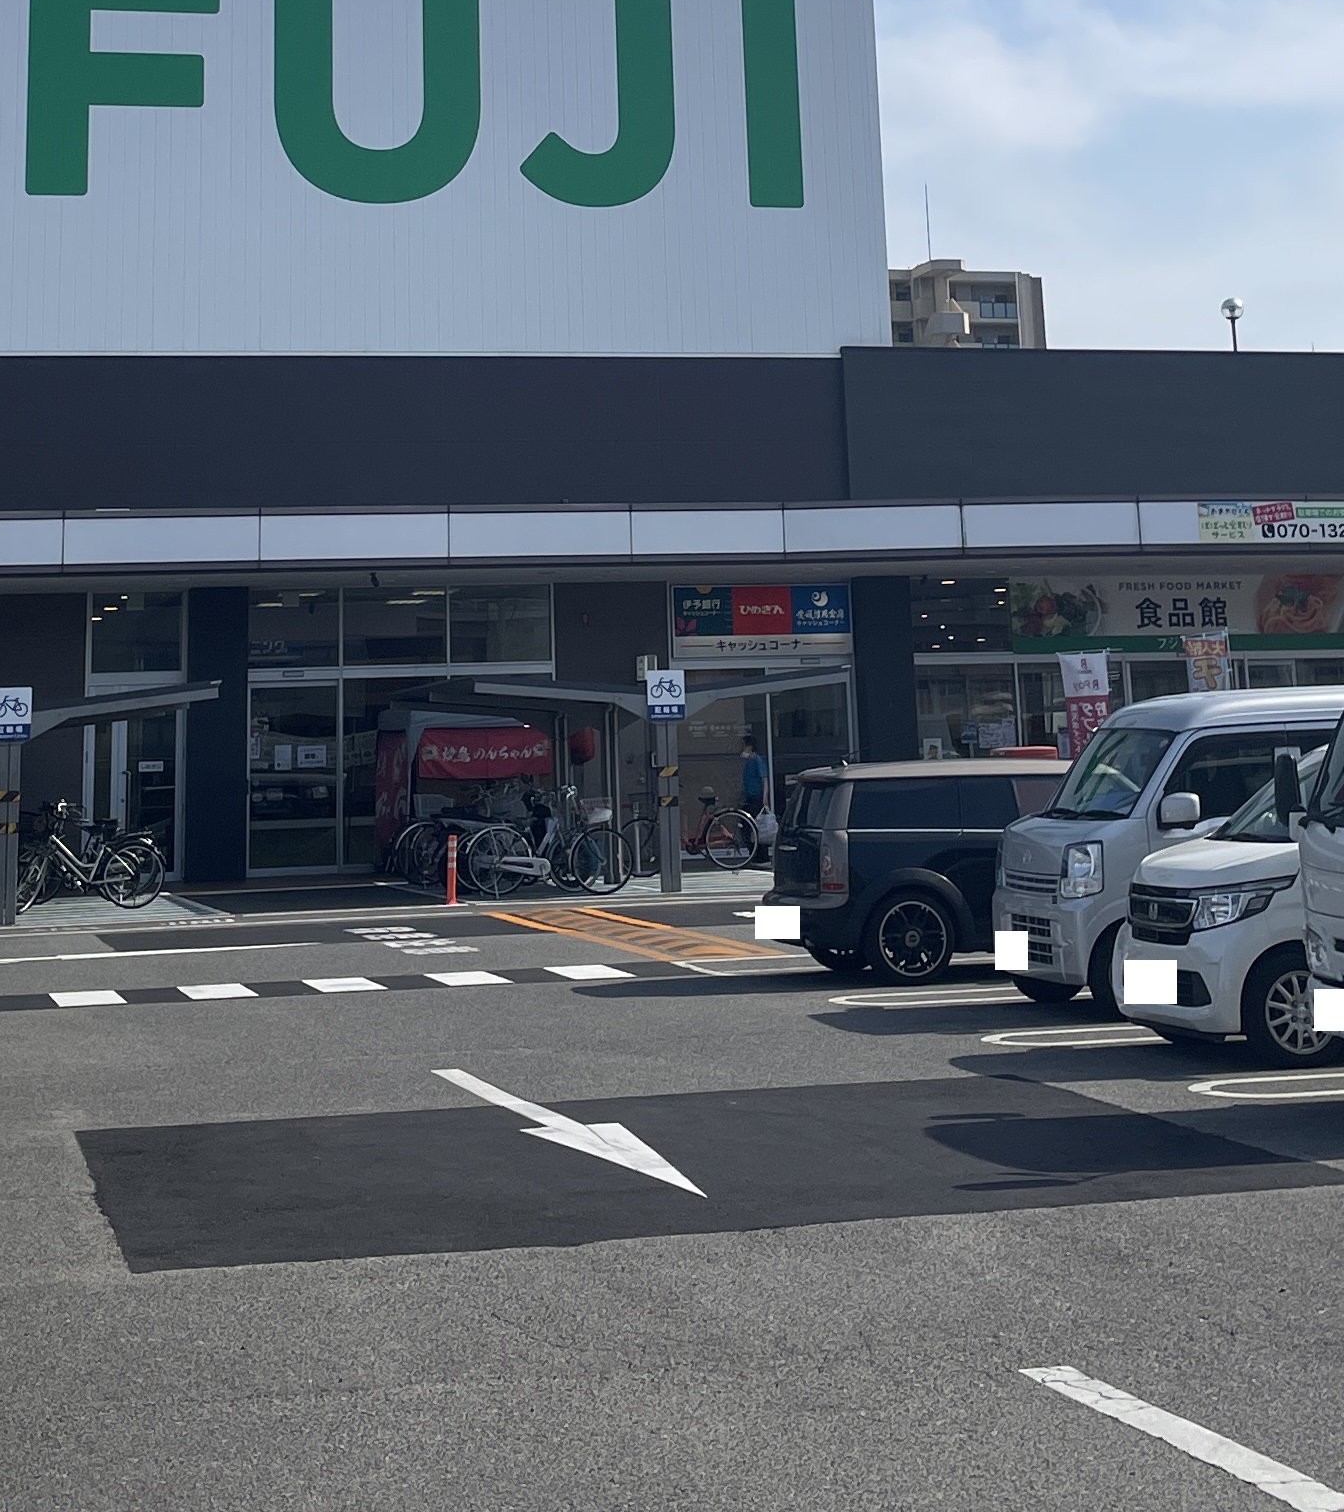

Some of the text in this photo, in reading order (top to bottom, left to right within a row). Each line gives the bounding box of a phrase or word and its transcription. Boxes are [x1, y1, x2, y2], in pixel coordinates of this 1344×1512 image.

[1118, 580, 1243, 591] FRESH FOOD MARKET
[1135, 596, 1228, 629] 食品館
[715, 638, 813, 652] キャッシュコーナー
